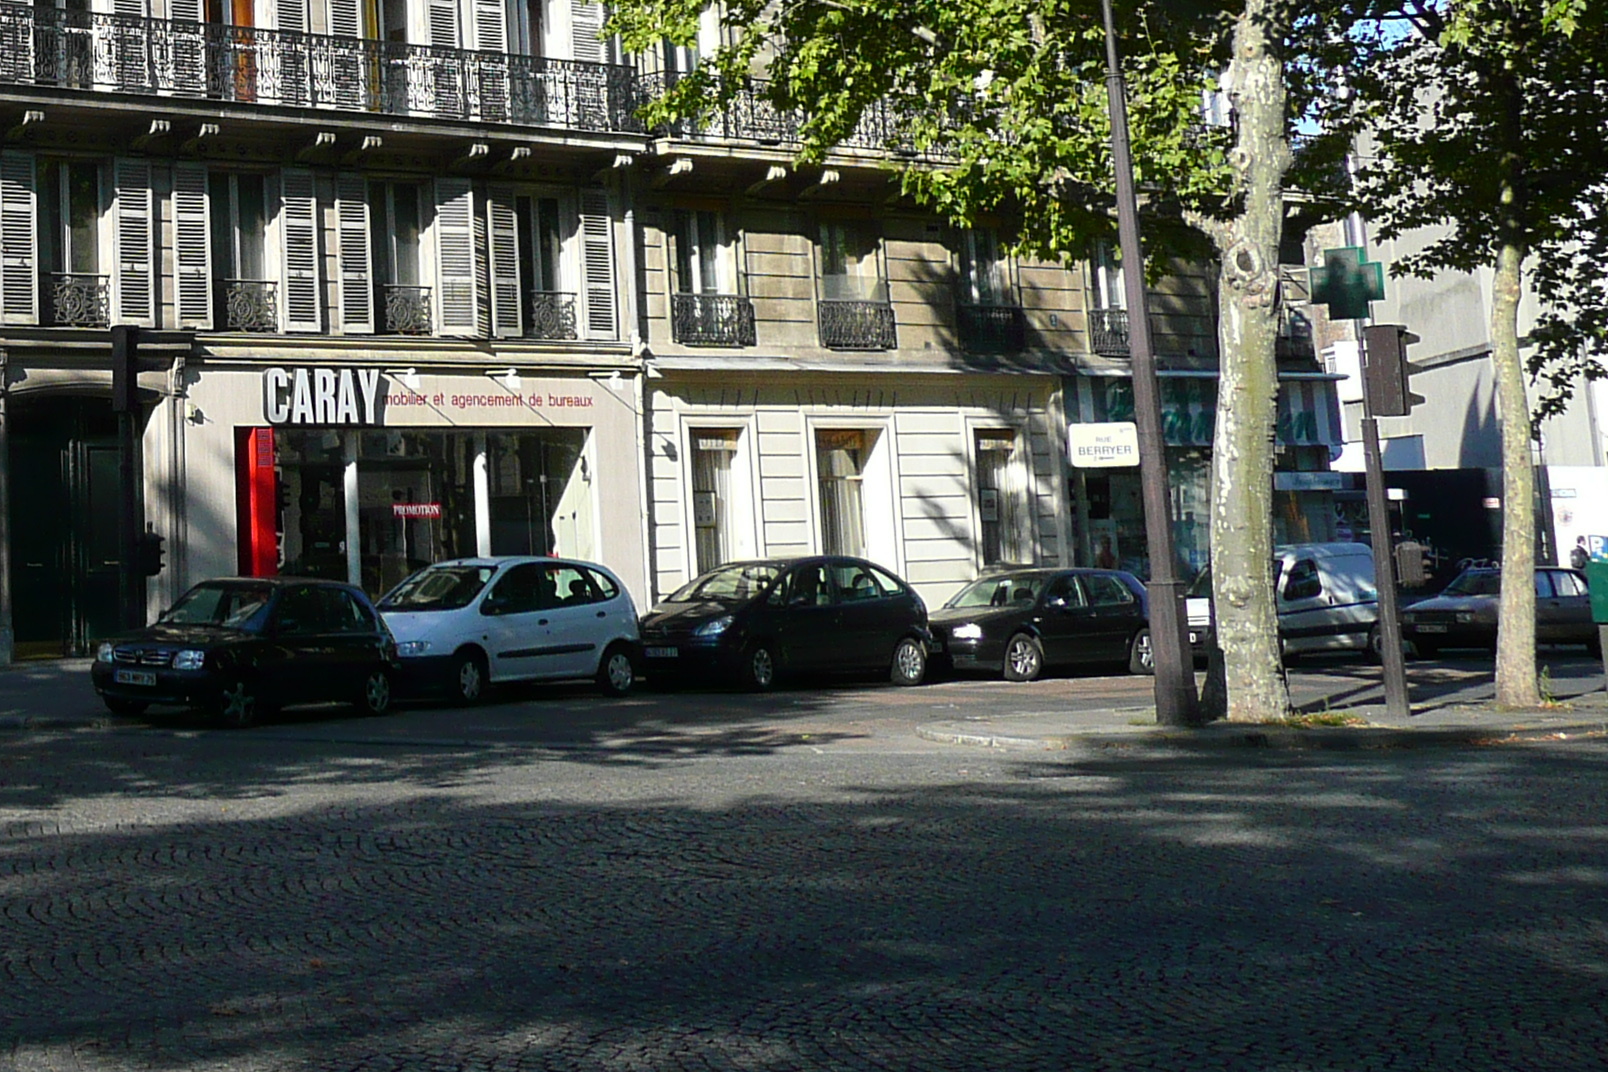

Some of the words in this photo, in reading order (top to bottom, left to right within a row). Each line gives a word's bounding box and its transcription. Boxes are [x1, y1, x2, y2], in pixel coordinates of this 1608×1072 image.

[264, 367, 379, 424] CARAY
[382, 391, 428, 406] mobilier
[433, 392, 445, 406] et
[451, 392, 524, 408] agencement
[528, 392, 543, 407] de
[548, 393, 593, 408] bureaux
[1078, 445, 1132, 456] BERRYER
[393, 504, 440, 516] PROMOTION
